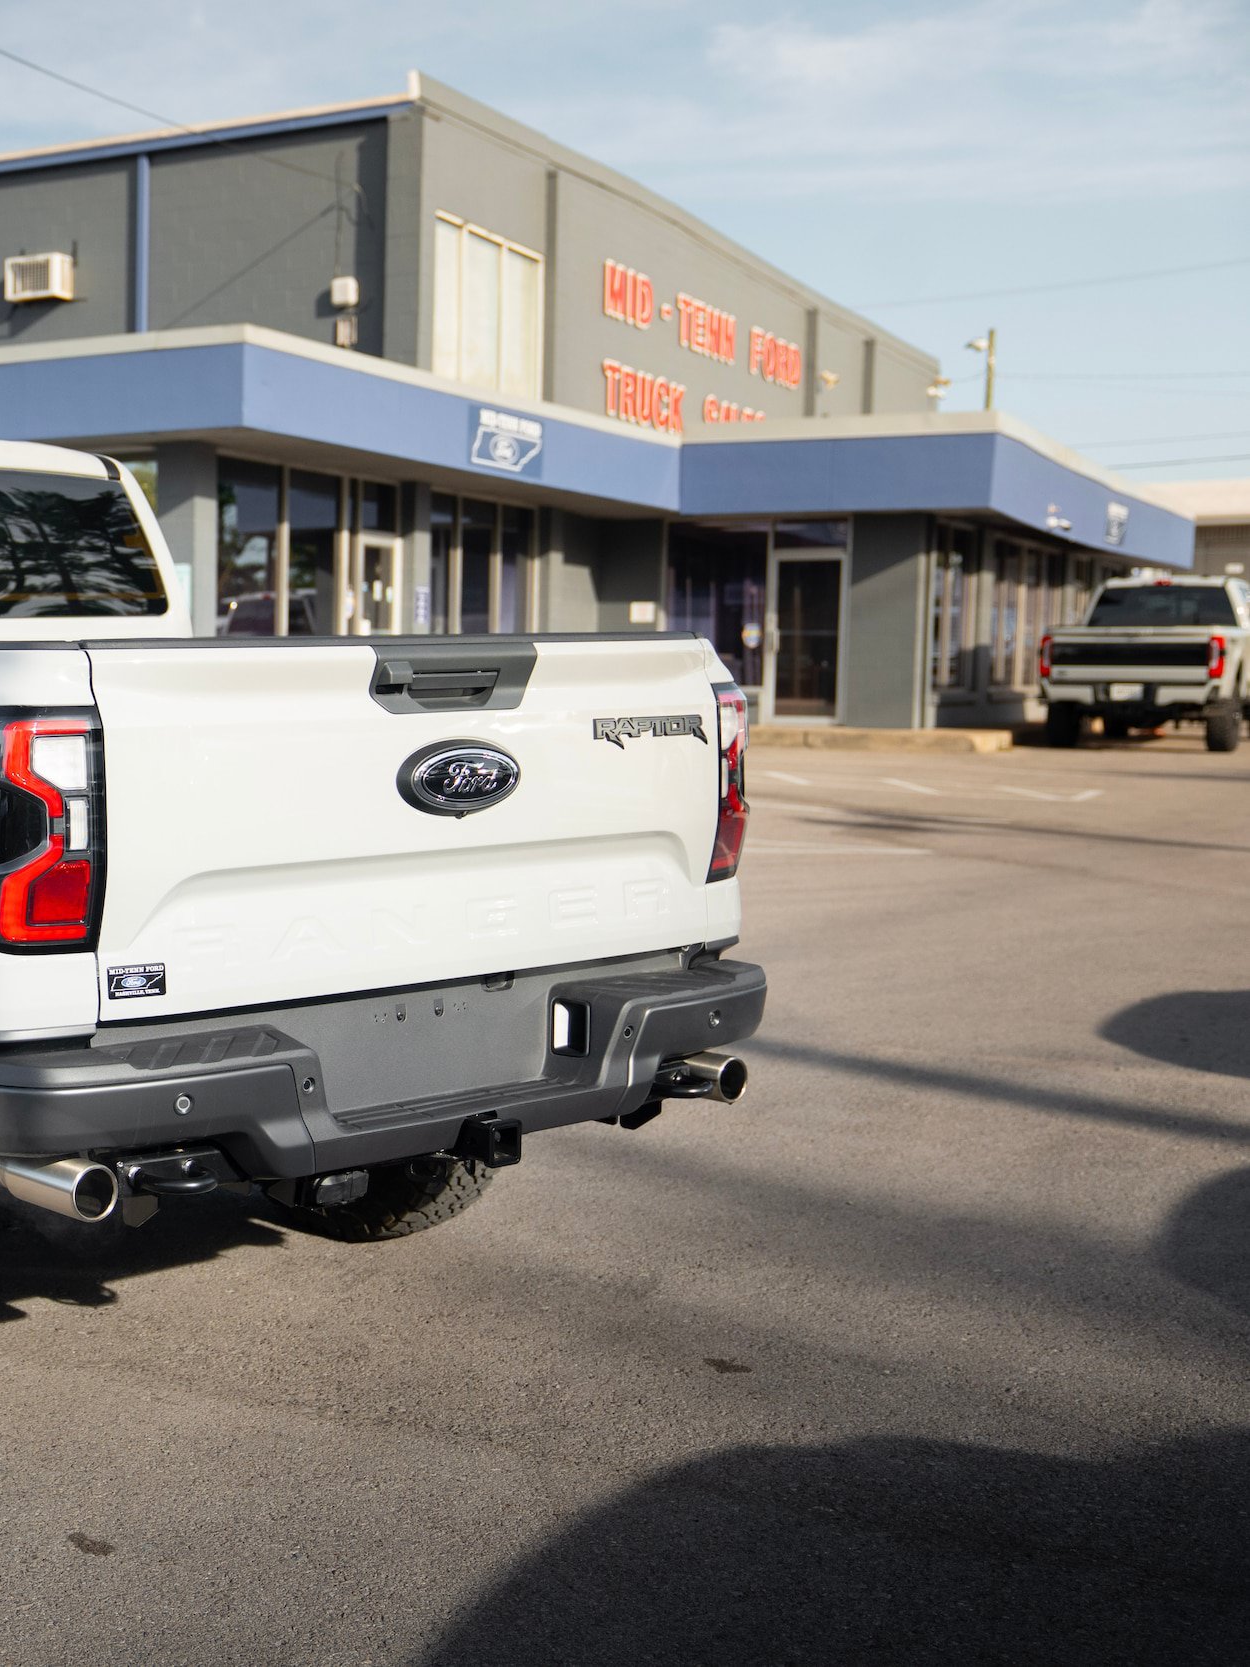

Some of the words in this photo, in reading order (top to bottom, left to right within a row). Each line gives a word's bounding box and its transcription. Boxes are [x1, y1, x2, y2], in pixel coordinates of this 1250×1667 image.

[603, 258, 654, 330] MID
[676, 291, 737, 366] TENN
[749, 325, 802, 390] FORD
[603, 356, 687, 437] TRUCK
[592, 714, 709, 750] RAPTOR
[442, 761, 498, 793] Ford
[170, 876, 672, 972] RANGER
[109, 967, 144, 975] MID-TENN
